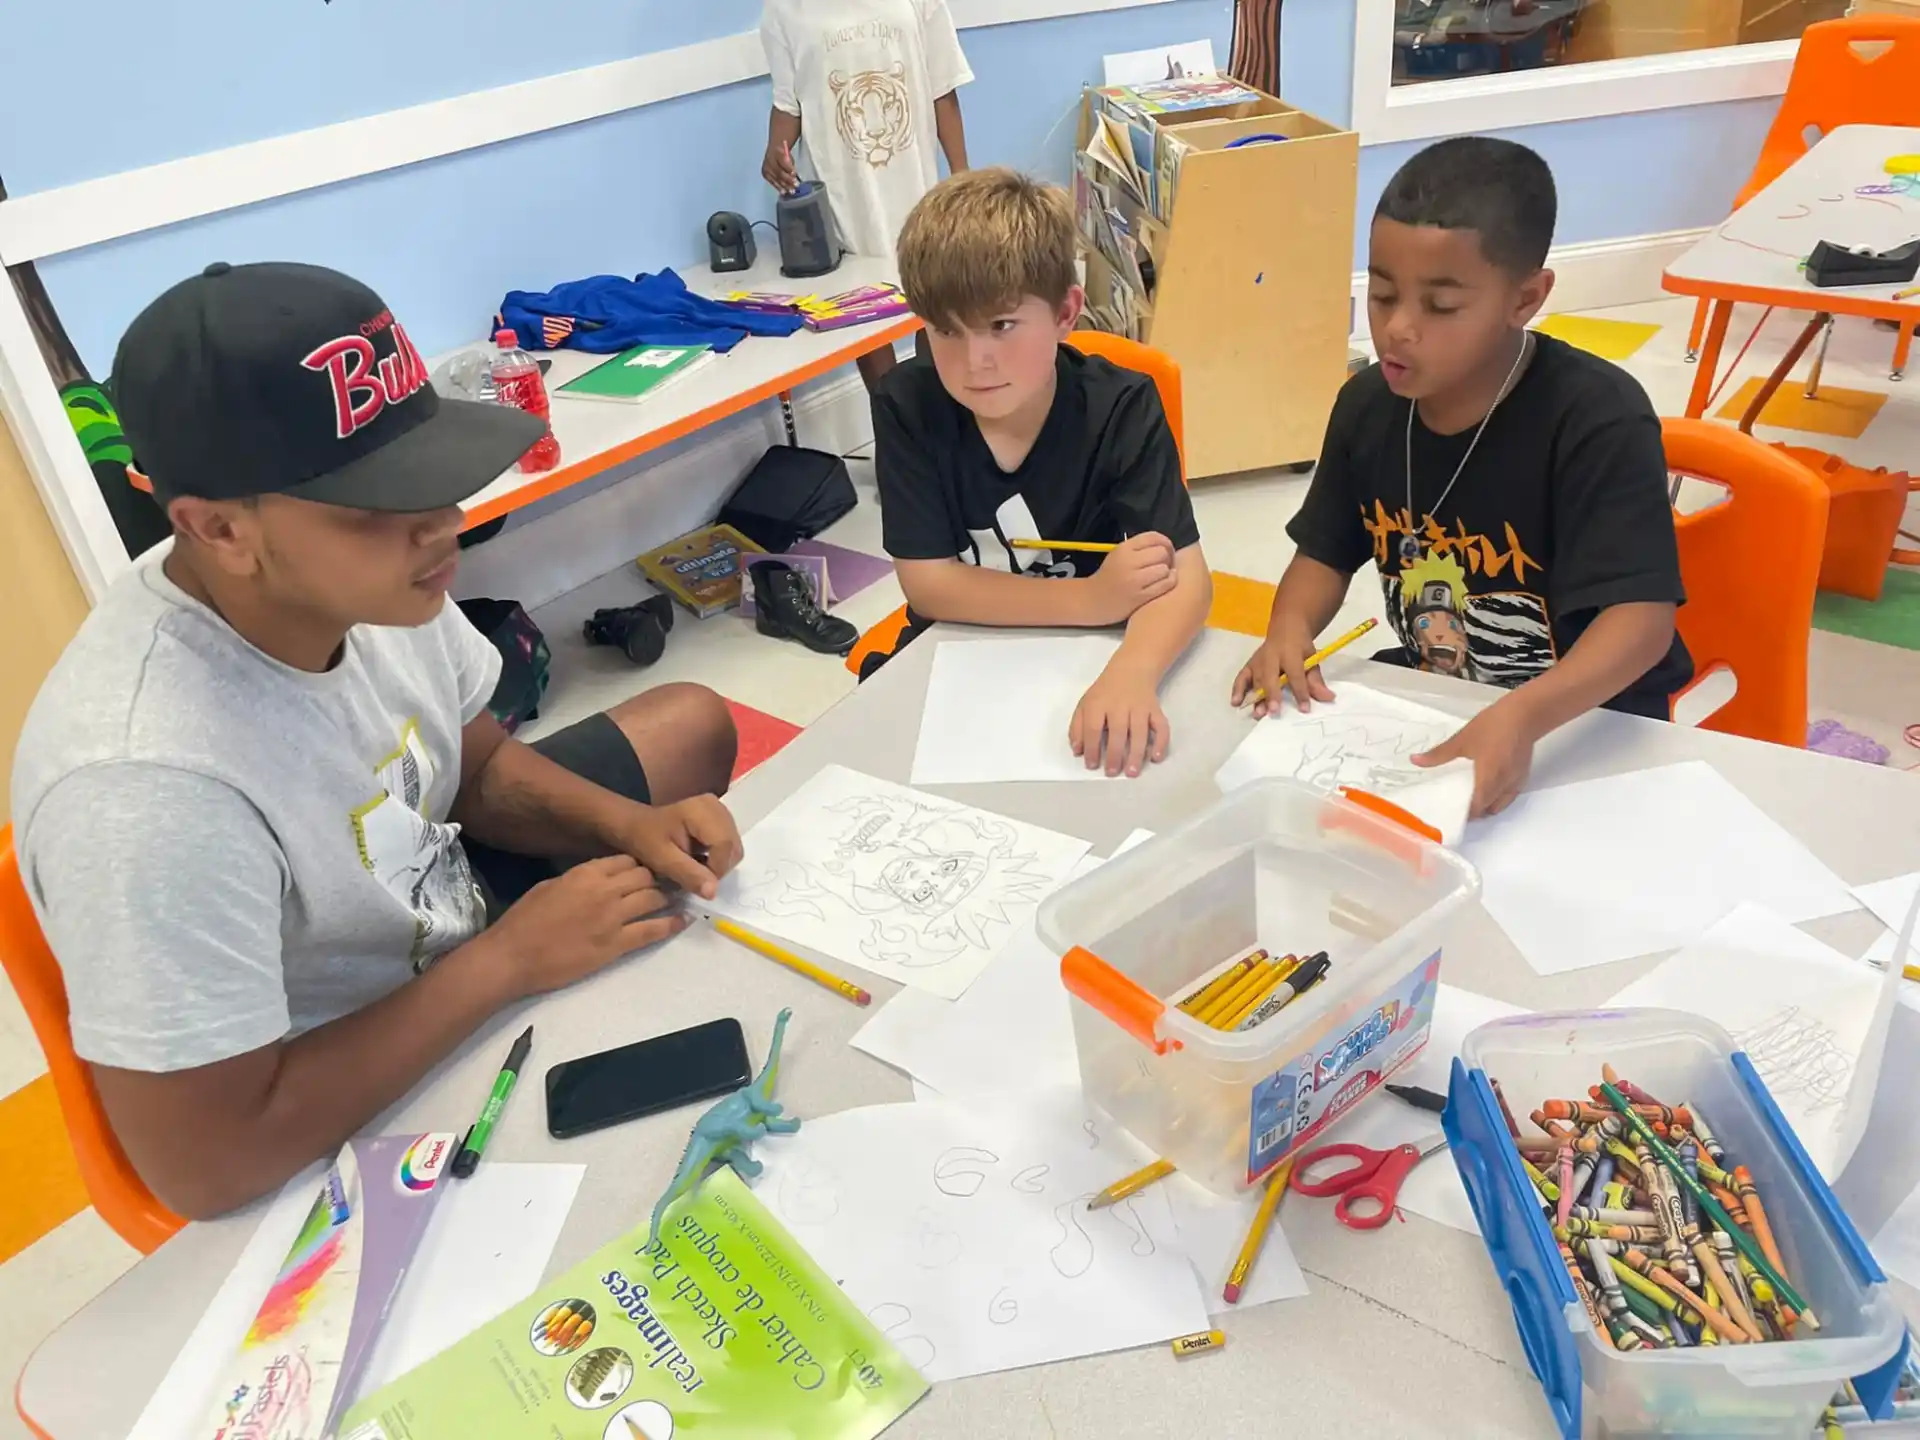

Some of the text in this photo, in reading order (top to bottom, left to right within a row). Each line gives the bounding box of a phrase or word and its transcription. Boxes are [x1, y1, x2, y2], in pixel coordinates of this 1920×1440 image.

[601, 1269, 704, 1393] realimages
[634, 1237, 737, 1350] Sketch Pad
[676, 1215, 825, 1390] Cahier de croquis
[1182, 1335, 1212, 1349] Pentel
[240, 1354, 290, 1429] Pastels
